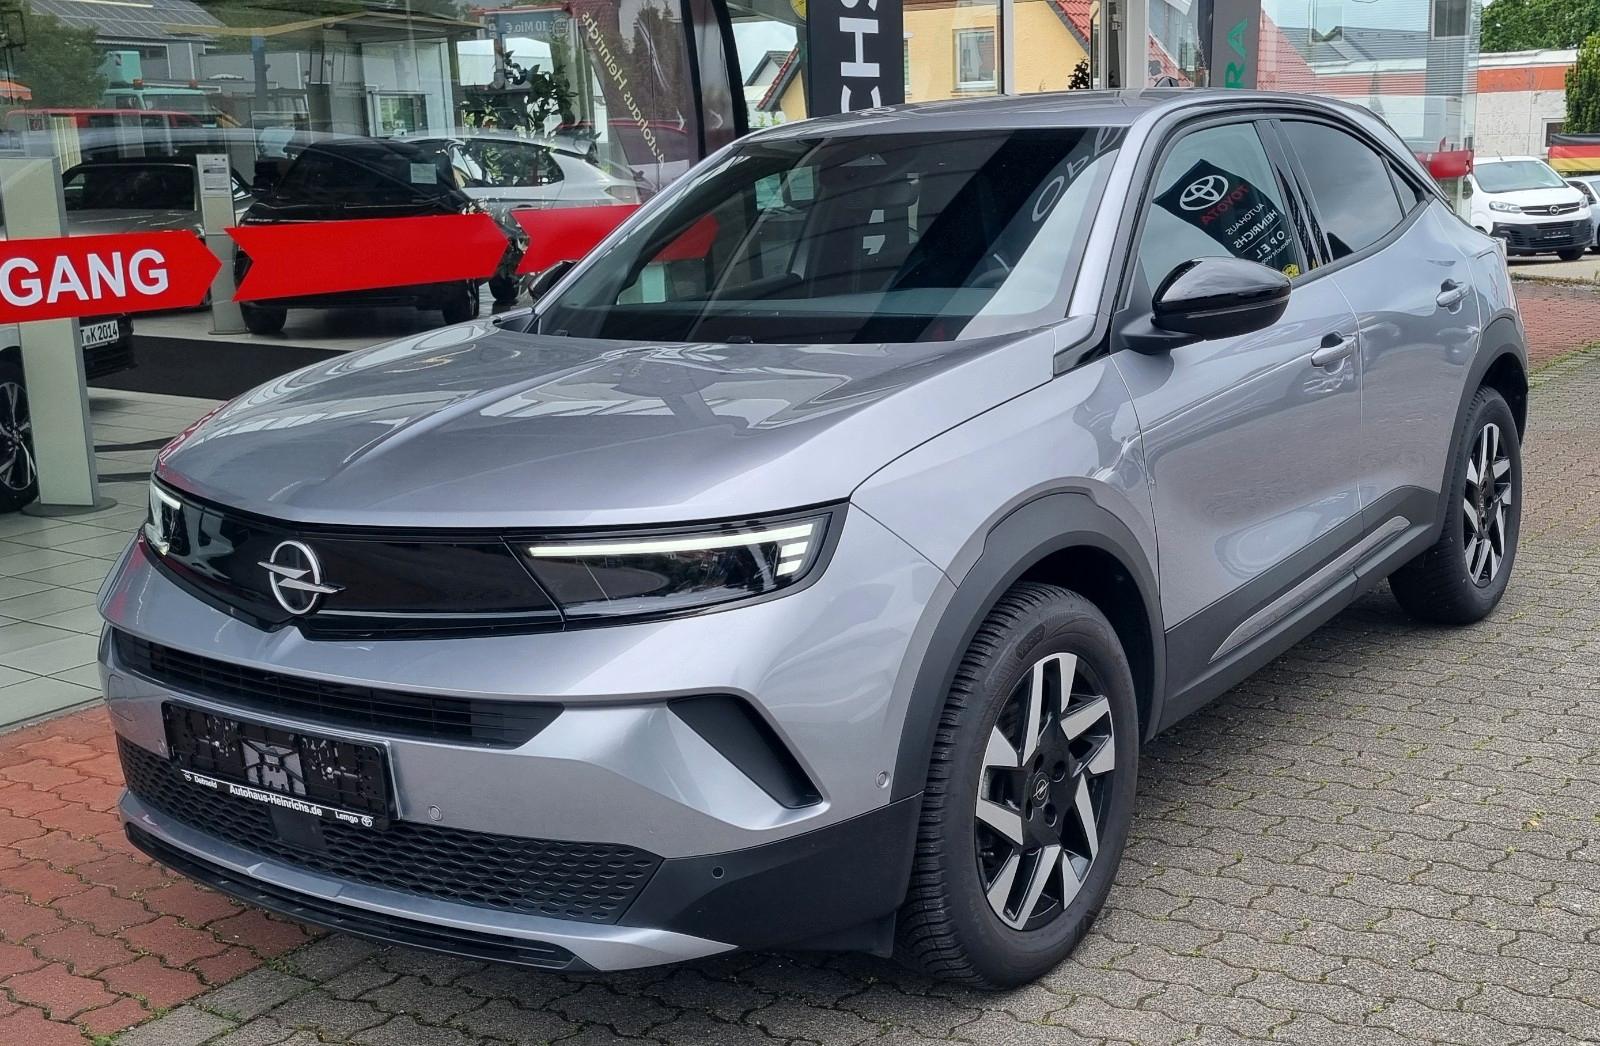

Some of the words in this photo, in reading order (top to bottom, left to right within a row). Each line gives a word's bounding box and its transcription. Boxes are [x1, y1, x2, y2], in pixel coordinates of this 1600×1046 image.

[0, 249, 168, 306] GANG
[229, 784, 323, 817] Autohaus-Heinrichs.de
[335, 810, 359, 824] Lemgo
